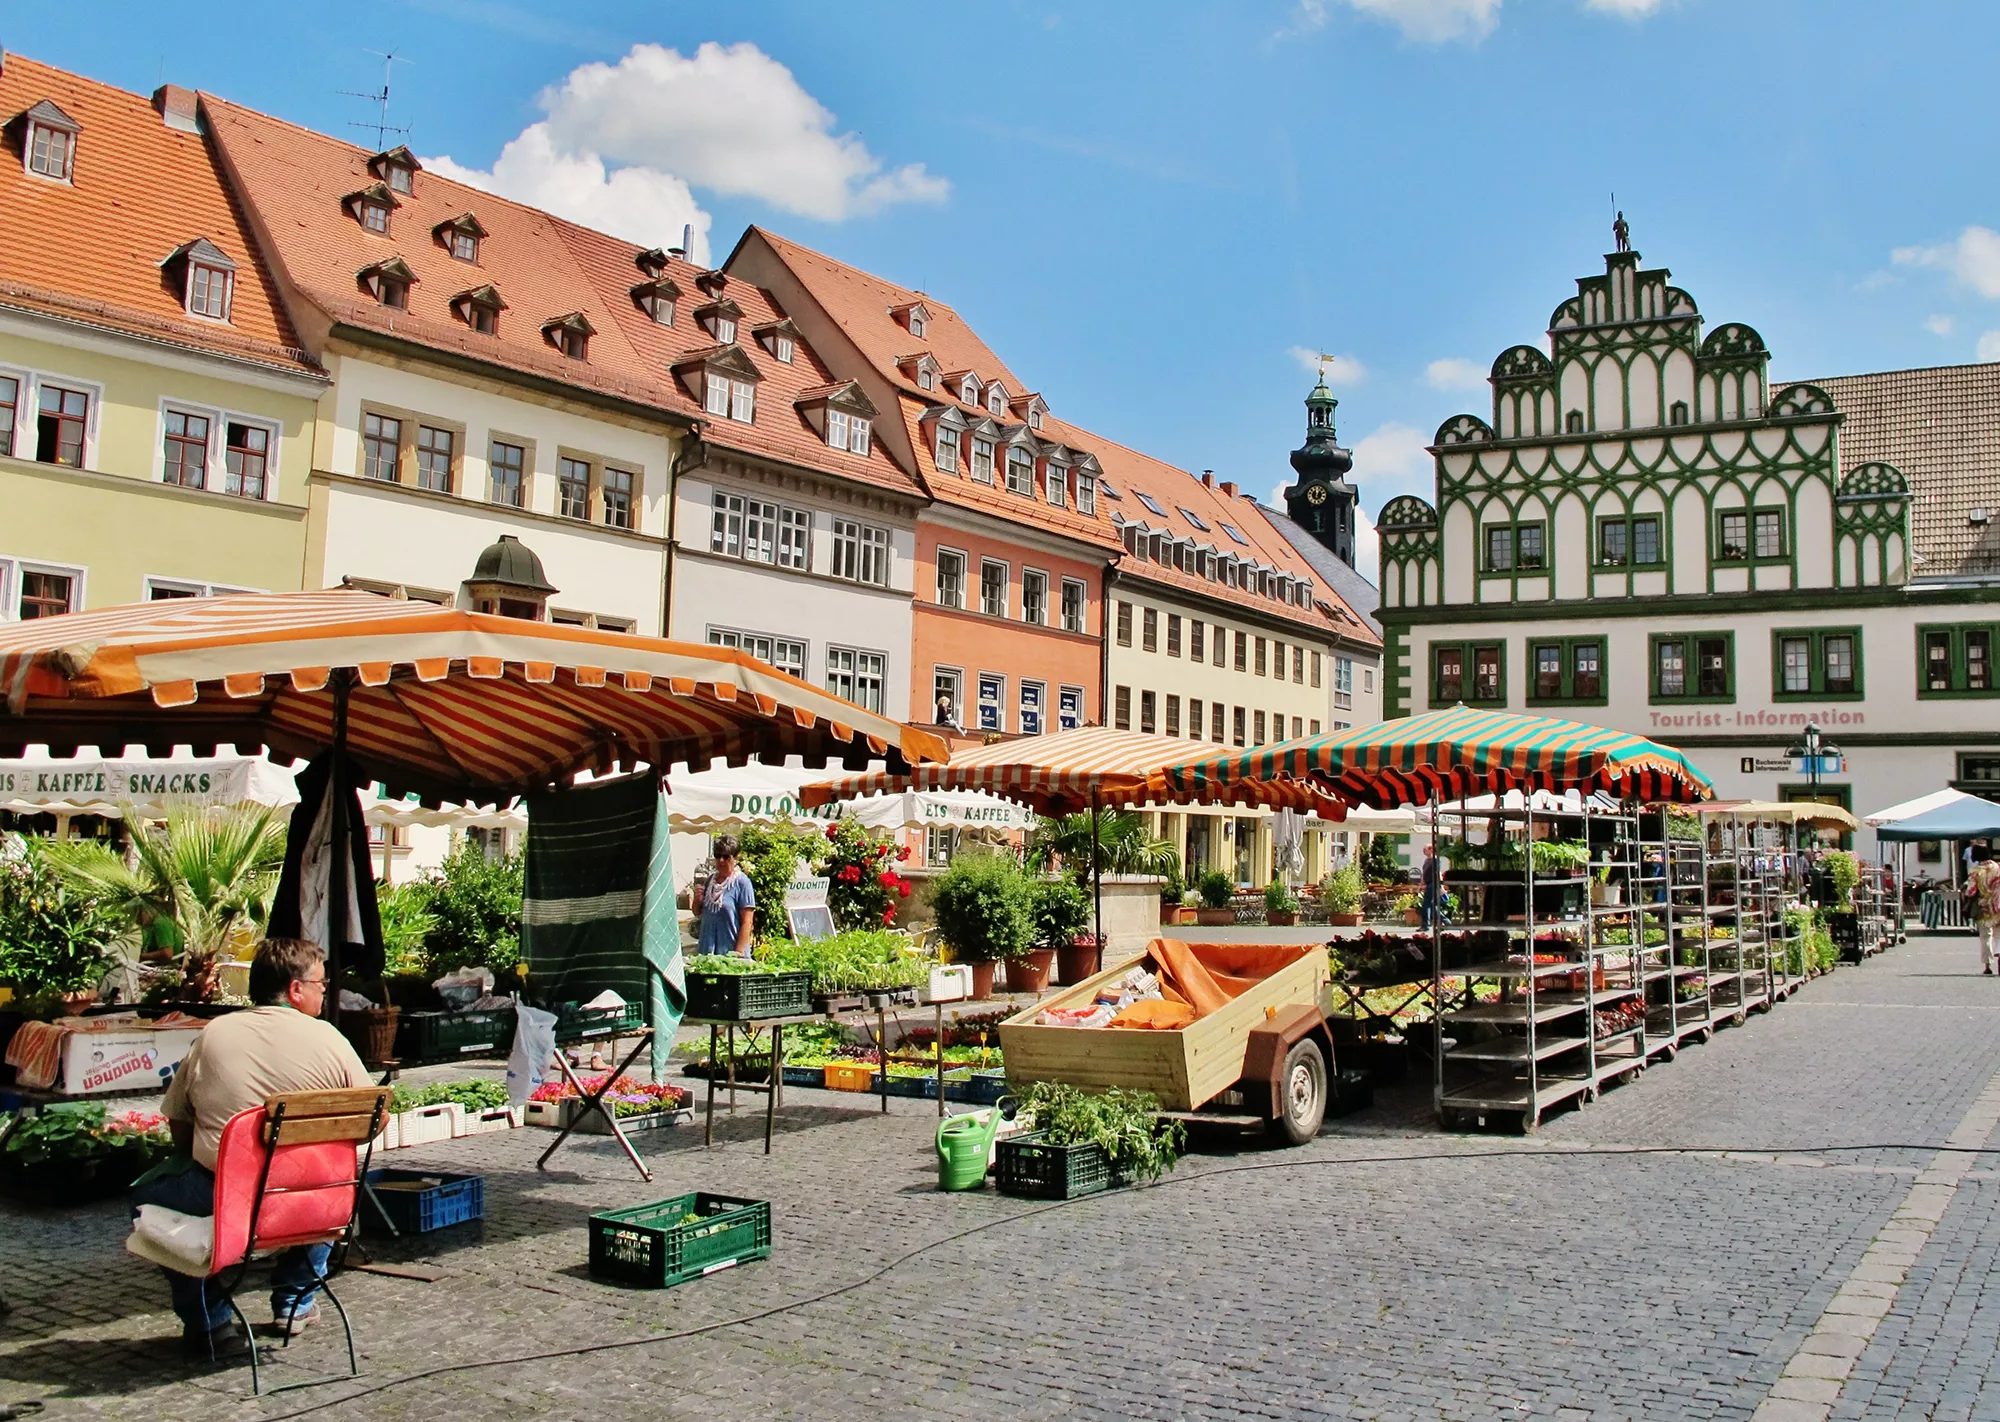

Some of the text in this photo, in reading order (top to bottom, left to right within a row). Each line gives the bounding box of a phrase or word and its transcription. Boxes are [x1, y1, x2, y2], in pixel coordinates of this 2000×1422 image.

[0, 773, 211, 793] IS KAFFEE SNACKS
[730, 794, 844, 820] DOLOMITI
[925, 803, 948, 818] EIS
[964, 806, 1010, 822] KAFFEE
[789, 881, 829, 890] DOLOMITI
[82, 1053, 153, 1090] Bananen
